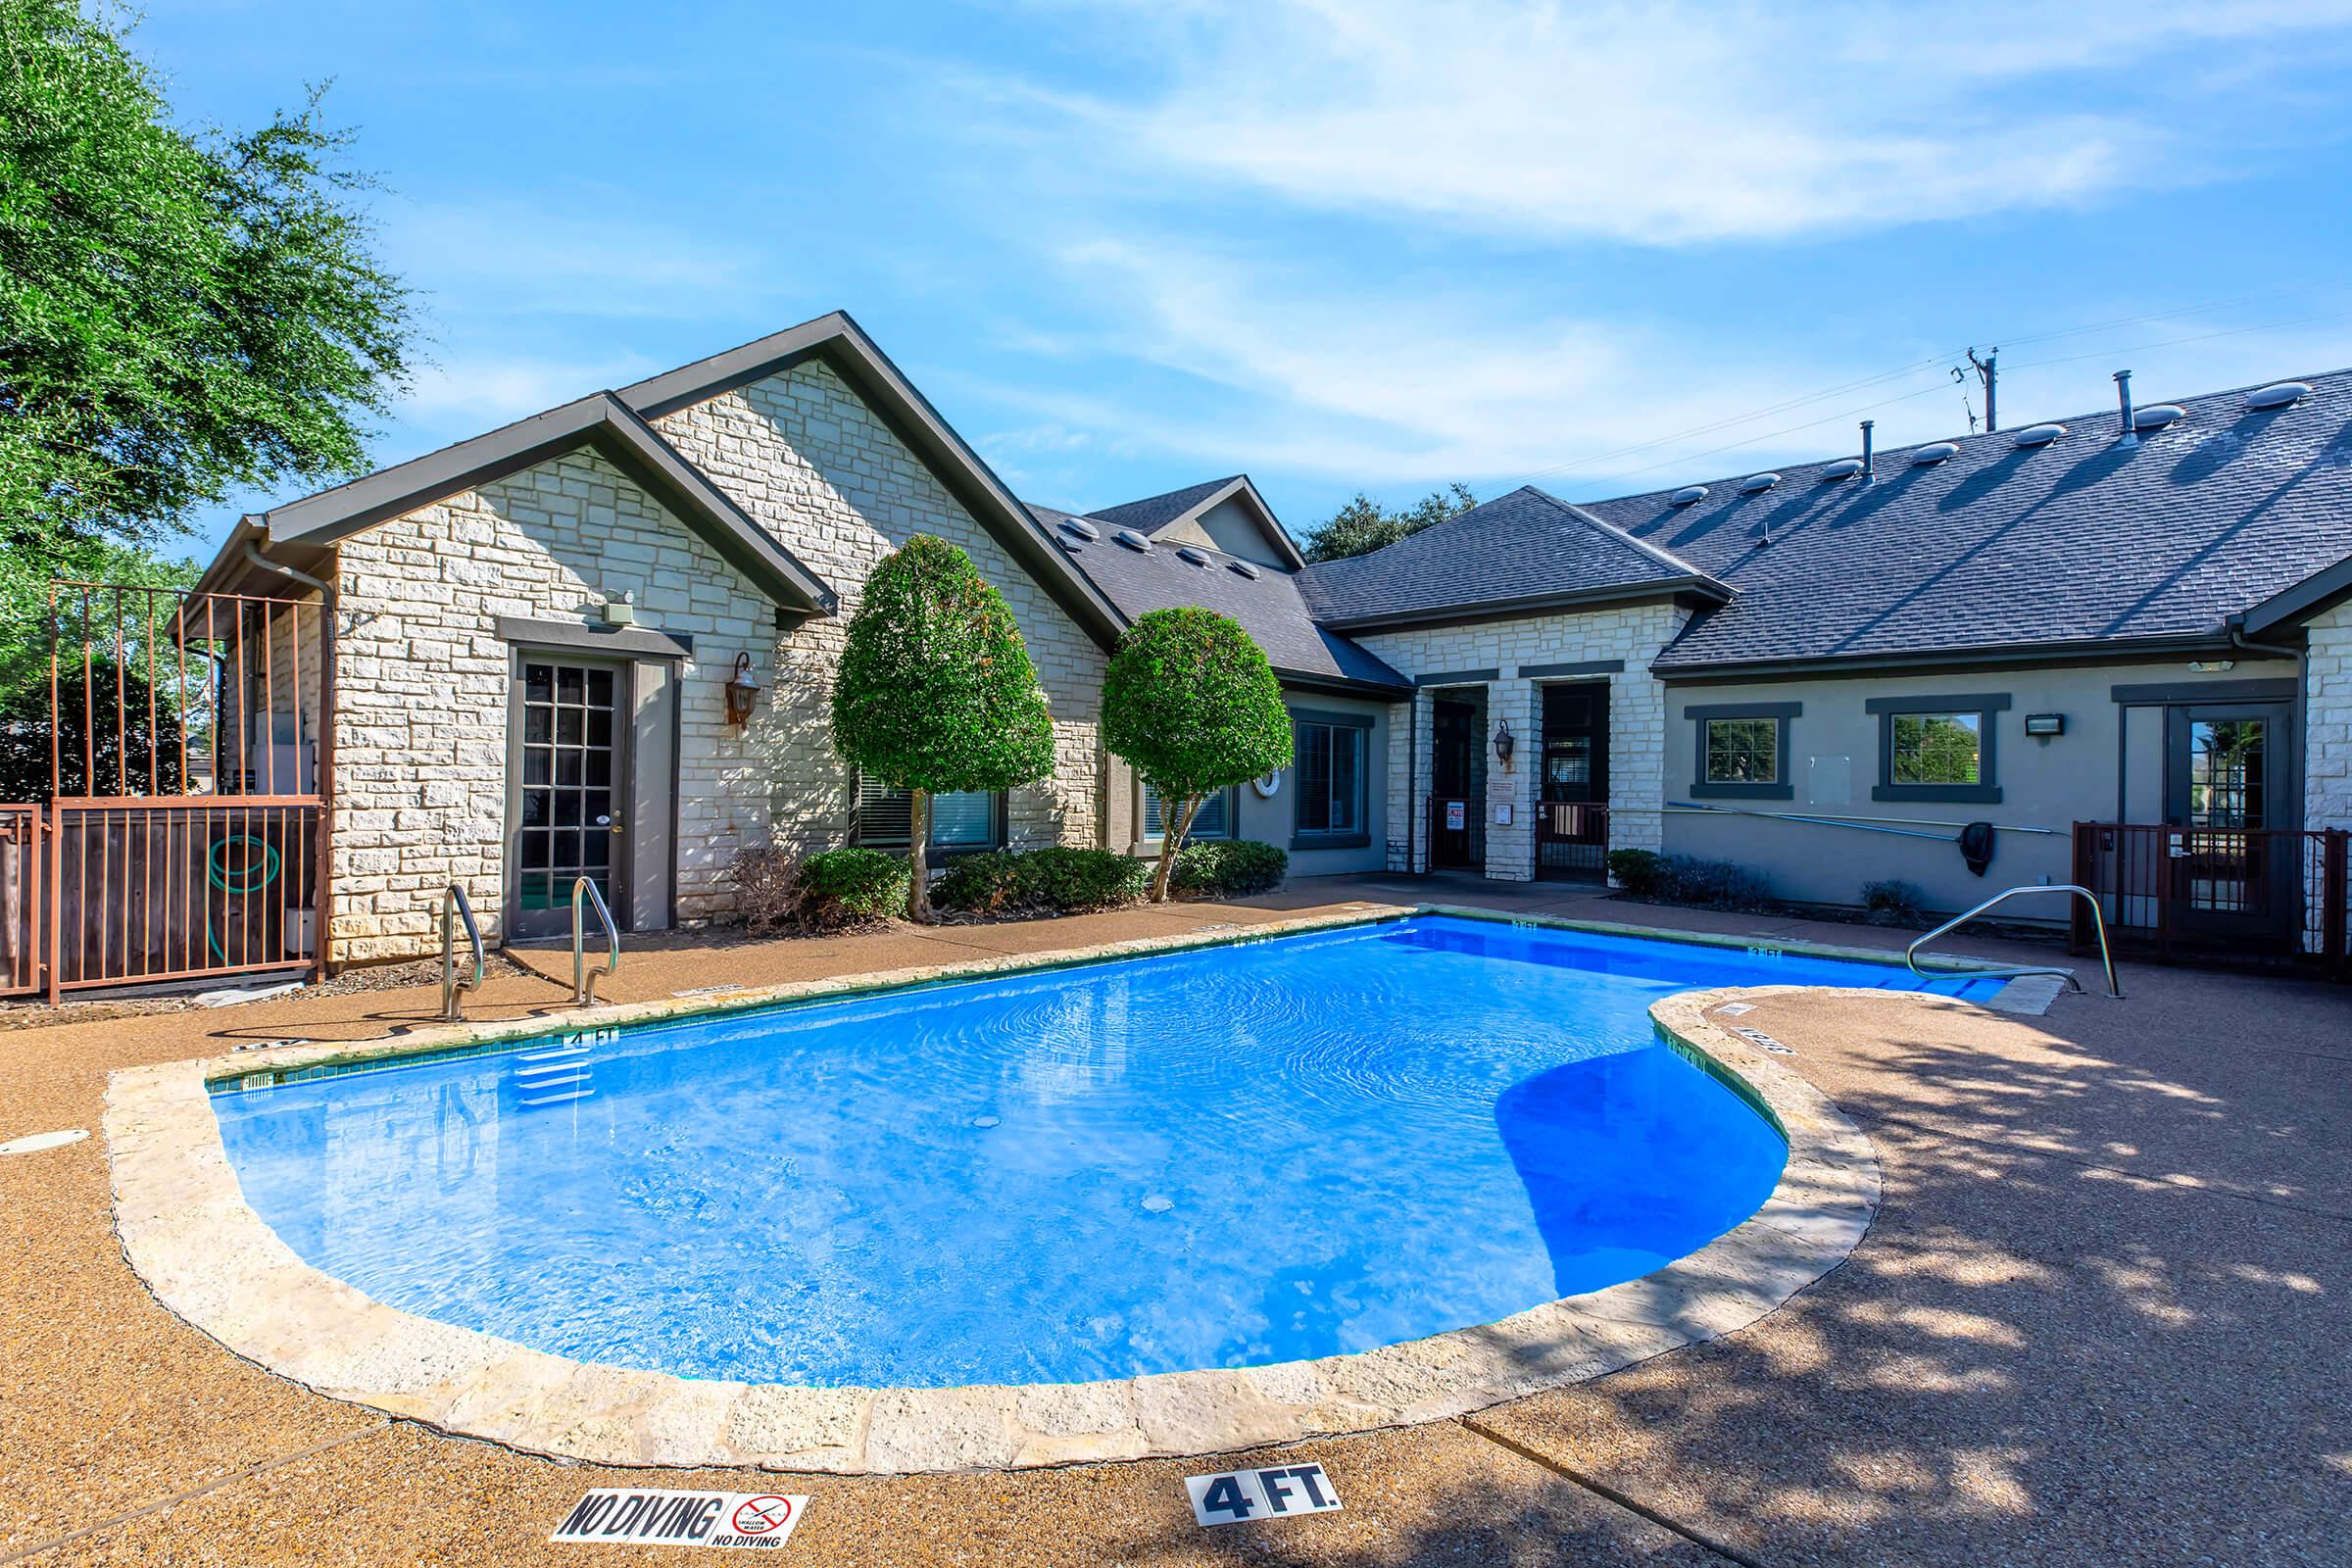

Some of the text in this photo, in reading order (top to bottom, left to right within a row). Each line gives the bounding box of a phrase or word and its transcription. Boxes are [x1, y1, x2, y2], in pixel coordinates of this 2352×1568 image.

[596, 1026, 614, 1041] FT
[1202, 1465, 1337, 1518] 4 FT.
[557, 1494, 723, 1539] NO DIVING
[711, 1535, 781, 1547] NO DIVING
